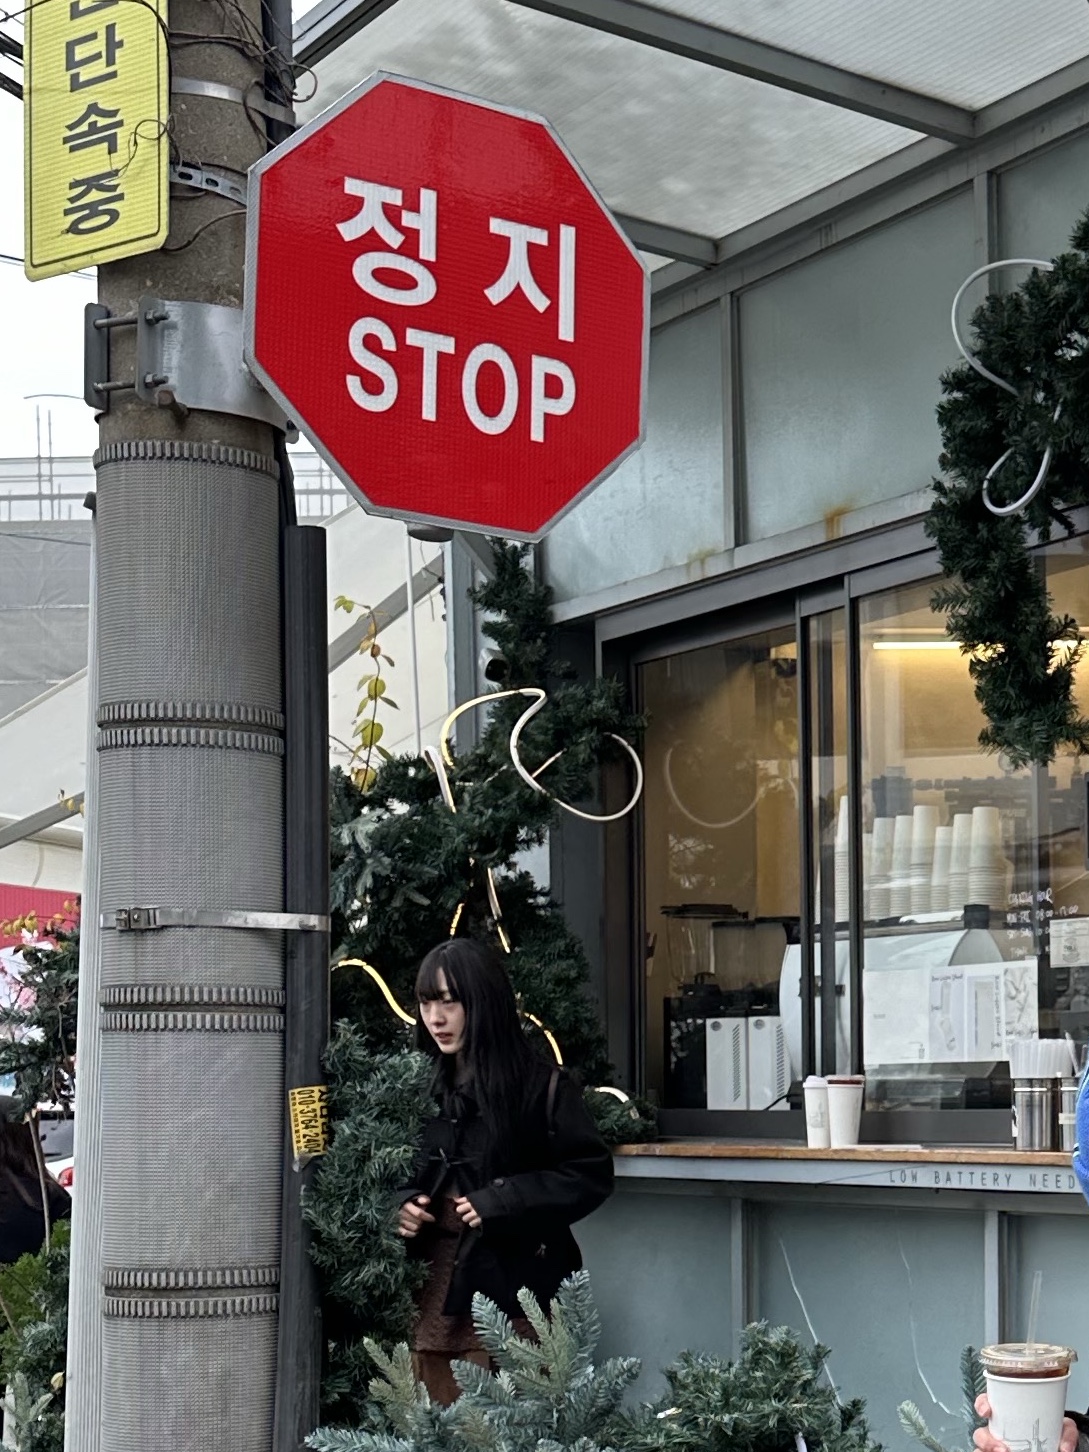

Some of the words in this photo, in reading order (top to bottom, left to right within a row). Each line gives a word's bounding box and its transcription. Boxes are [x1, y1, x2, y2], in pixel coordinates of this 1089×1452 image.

[345, 316, 577, 443] STOP
[890, 1170, 918, 1183] LOW
[934, 1171, 1012, 1187] BATTERY
